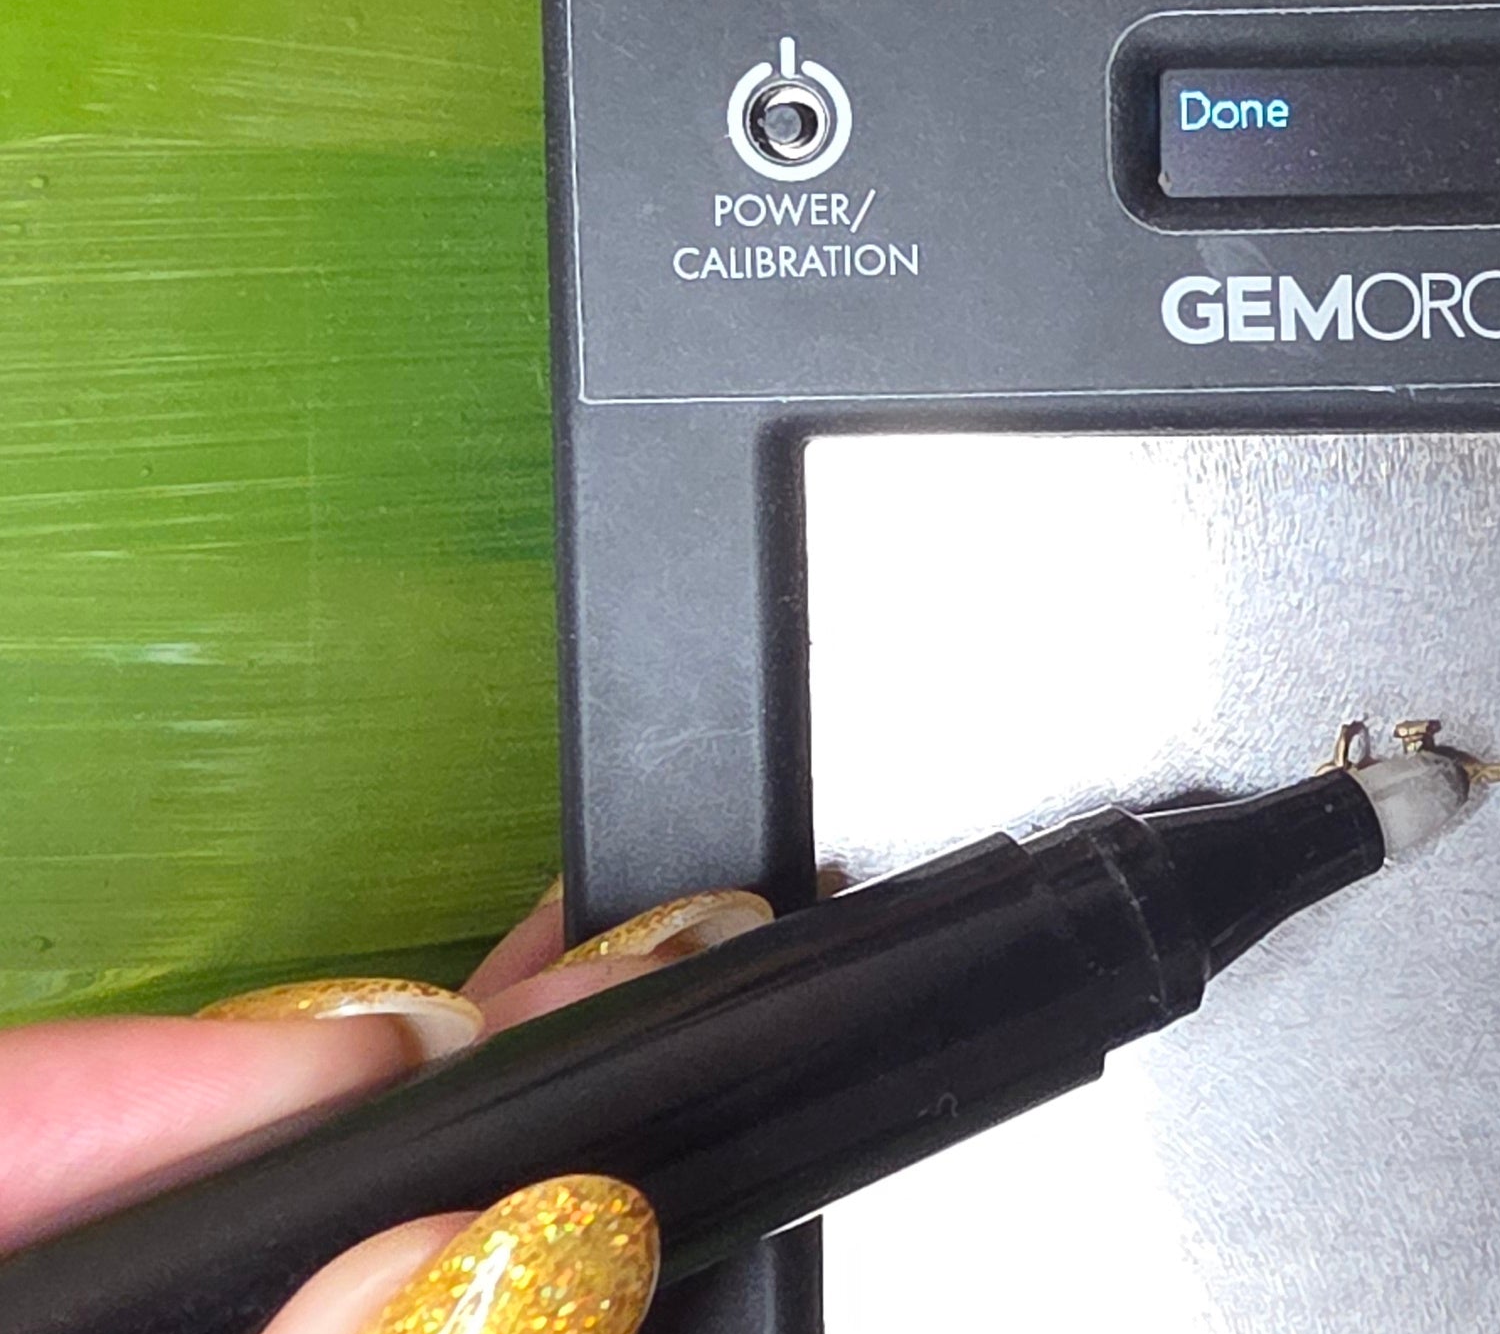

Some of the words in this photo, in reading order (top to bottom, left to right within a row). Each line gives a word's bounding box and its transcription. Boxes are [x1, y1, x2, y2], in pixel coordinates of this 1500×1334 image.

[1179, 90, 1290, 131] Done
[714, 188, 876, 233] POWER/
[672, 243, 919, 280] CALIBRATION
